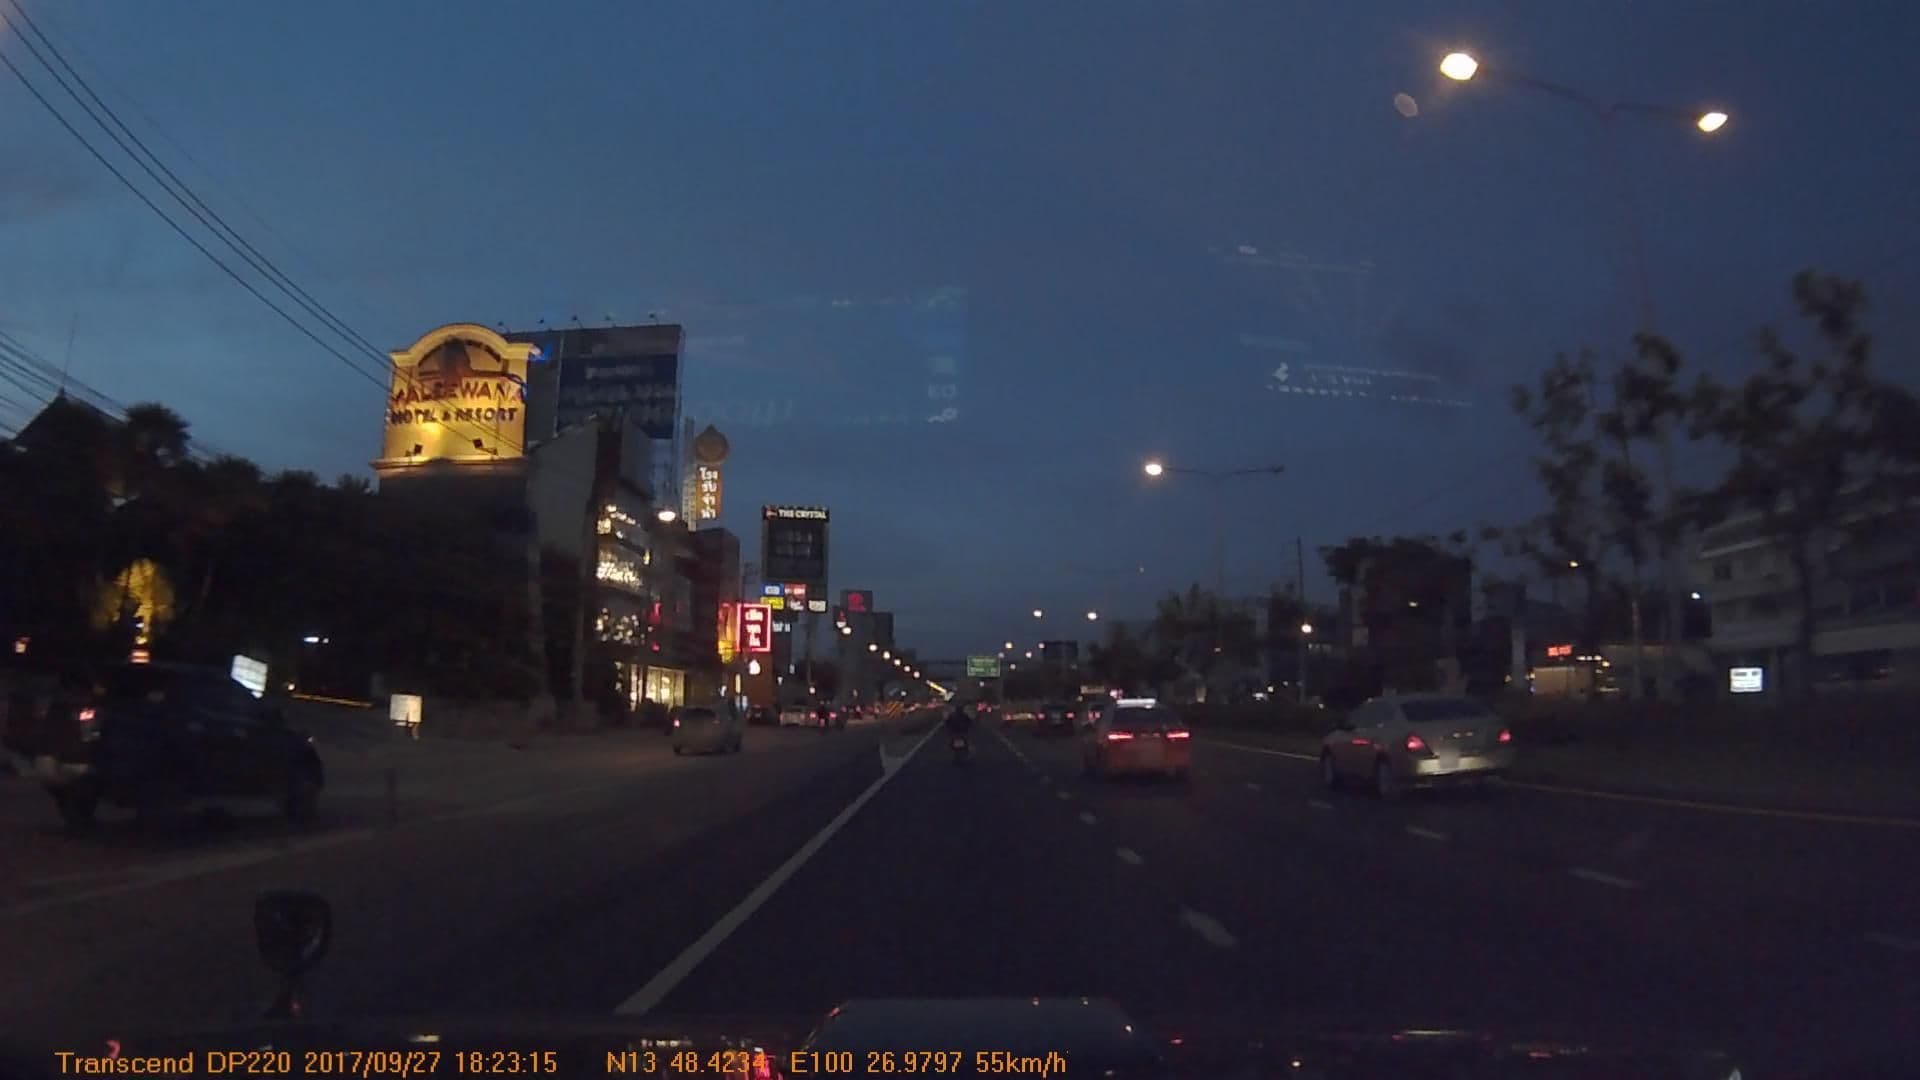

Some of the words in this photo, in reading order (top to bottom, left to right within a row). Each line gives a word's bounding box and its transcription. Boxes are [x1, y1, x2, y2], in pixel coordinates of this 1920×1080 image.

[391, 408, 438, 424] HOTEL
[455, 407, 518, 422] RESORT
[778, 508, 794, 519] THE
